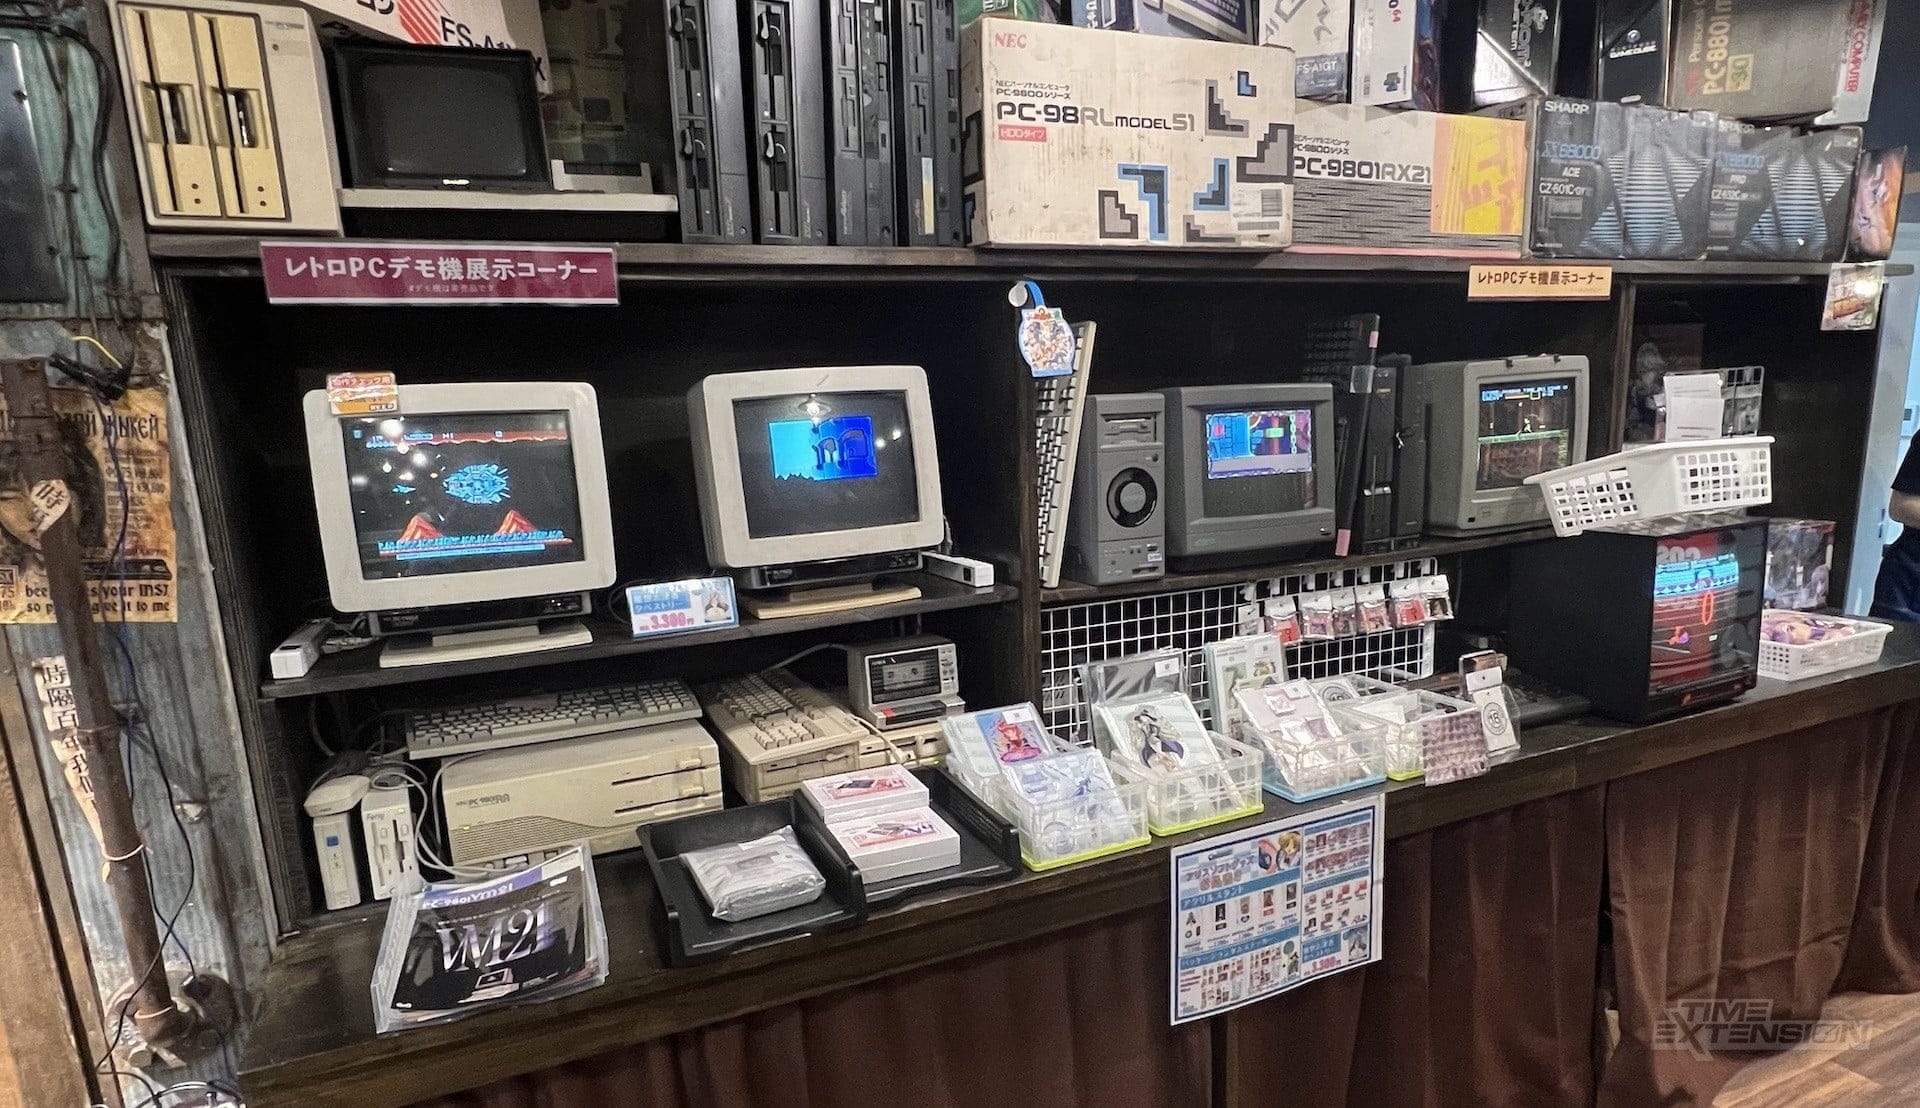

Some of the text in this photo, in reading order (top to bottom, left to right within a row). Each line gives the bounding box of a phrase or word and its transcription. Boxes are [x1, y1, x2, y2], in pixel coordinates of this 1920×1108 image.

[994, 33, 1028, 49] NEC
[1544, 100, 1590, 115] SHARP
[285, 256, 598, 281] レトロPCデモ機展示コーナー
[1478, 271, 1604, 286] レトロPCデモ機展示コーナー
